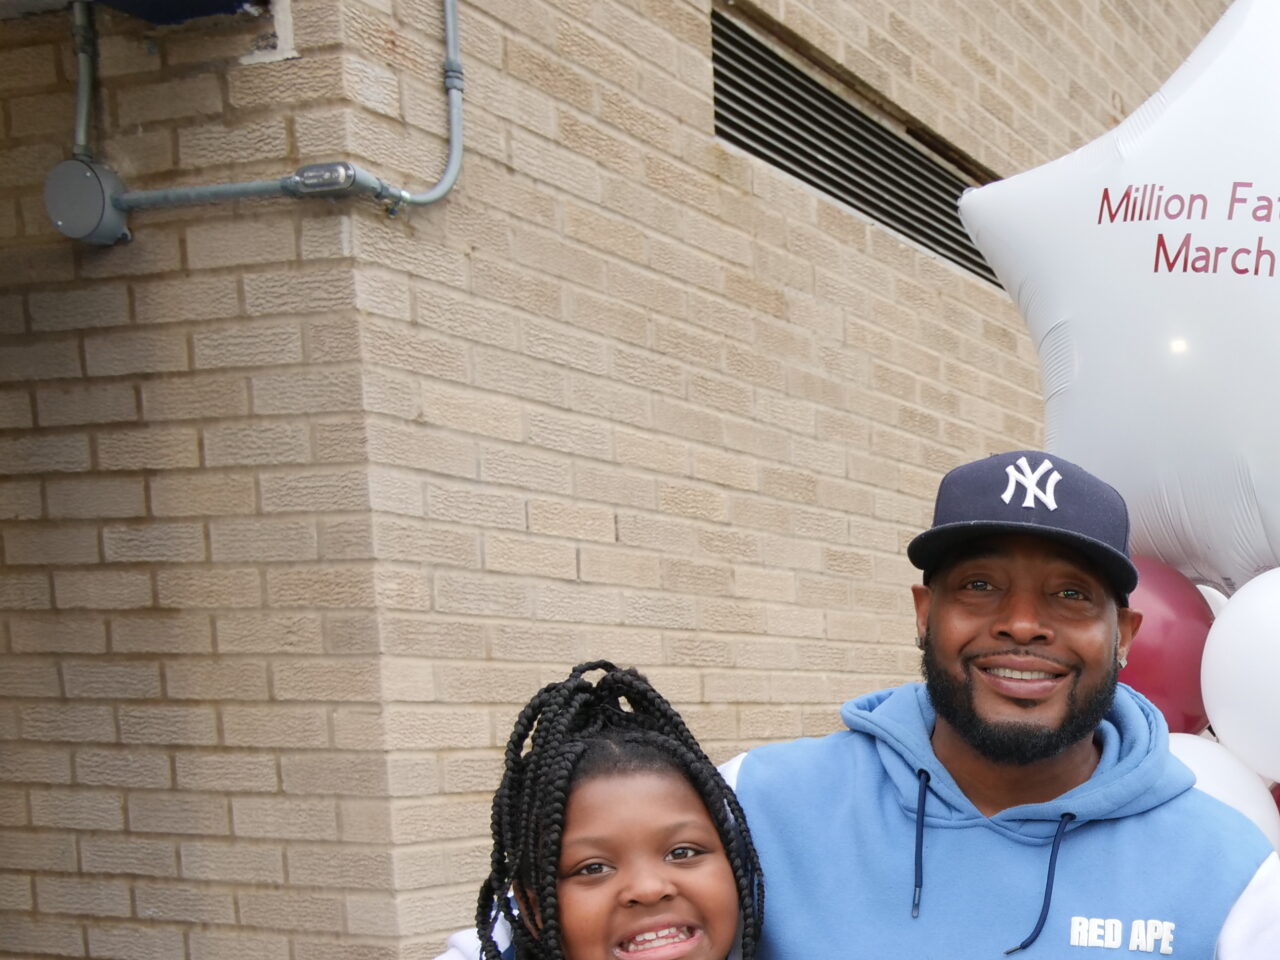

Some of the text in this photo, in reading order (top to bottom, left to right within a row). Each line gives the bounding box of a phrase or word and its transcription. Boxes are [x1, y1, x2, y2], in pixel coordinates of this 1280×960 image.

[1098, 183, 1209, 225] Million
[1154, 233, 1276, 277] March
[1000, 455, 1063, 511] NY
[1070, 916, 1176, 955] RED APE
